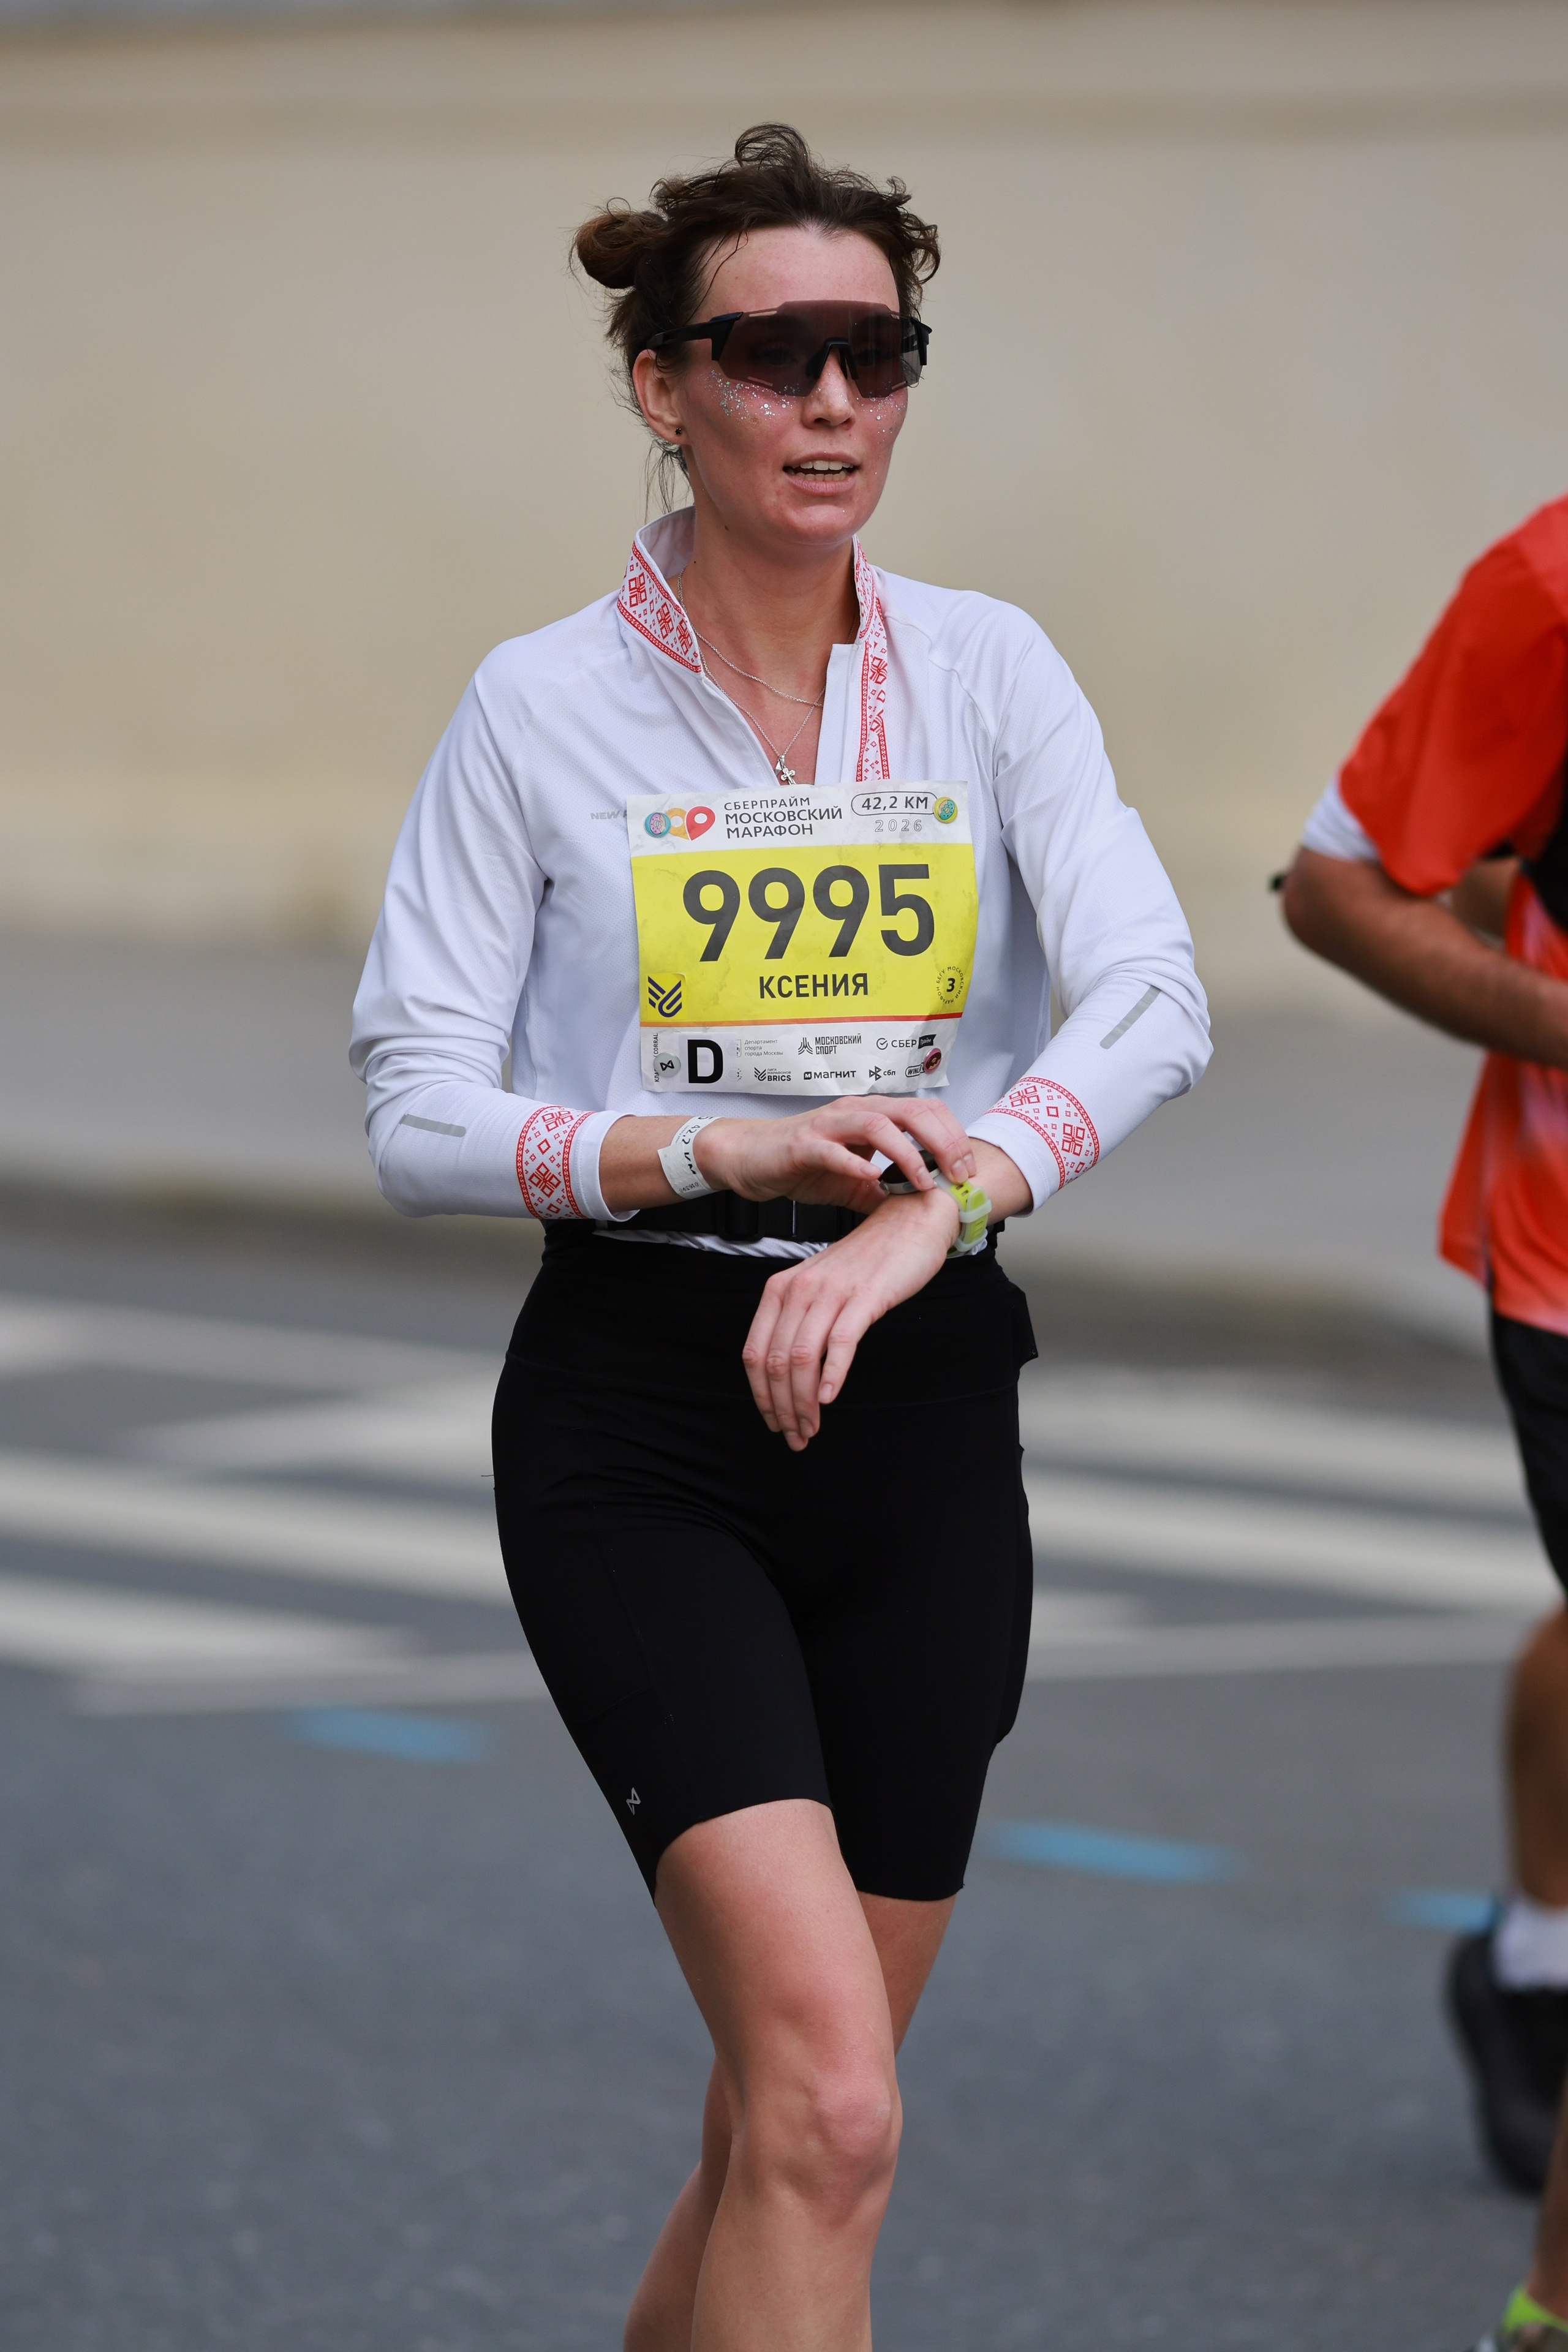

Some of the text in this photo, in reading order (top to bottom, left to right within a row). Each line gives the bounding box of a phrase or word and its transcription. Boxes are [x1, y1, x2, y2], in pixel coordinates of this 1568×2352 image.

[724, 796, 810, 810] СБЕРПРАЙМ
[861, 796, 928, 811] 42,2 КМ
[590, 810, 620, 820] NEW
[725, 805, 842, 824] МОСКОВСКИЙ
[726, 823, 813, 839] МАРАФОН
[875, 819, 922, 832] 2026
[683, 864, 935, 962] 9995
[759, 973, 869, 999] КСЕНИЯ
[946, 978, 956, 992] 3
[815, 1033, 862, 1046] МОСКОВСКИЙ
[891, 1039, 917, 1048] СБЕР
[815, 1045, 837, 1055] СПОРТ
[687, 1039, 723, 1084] D
